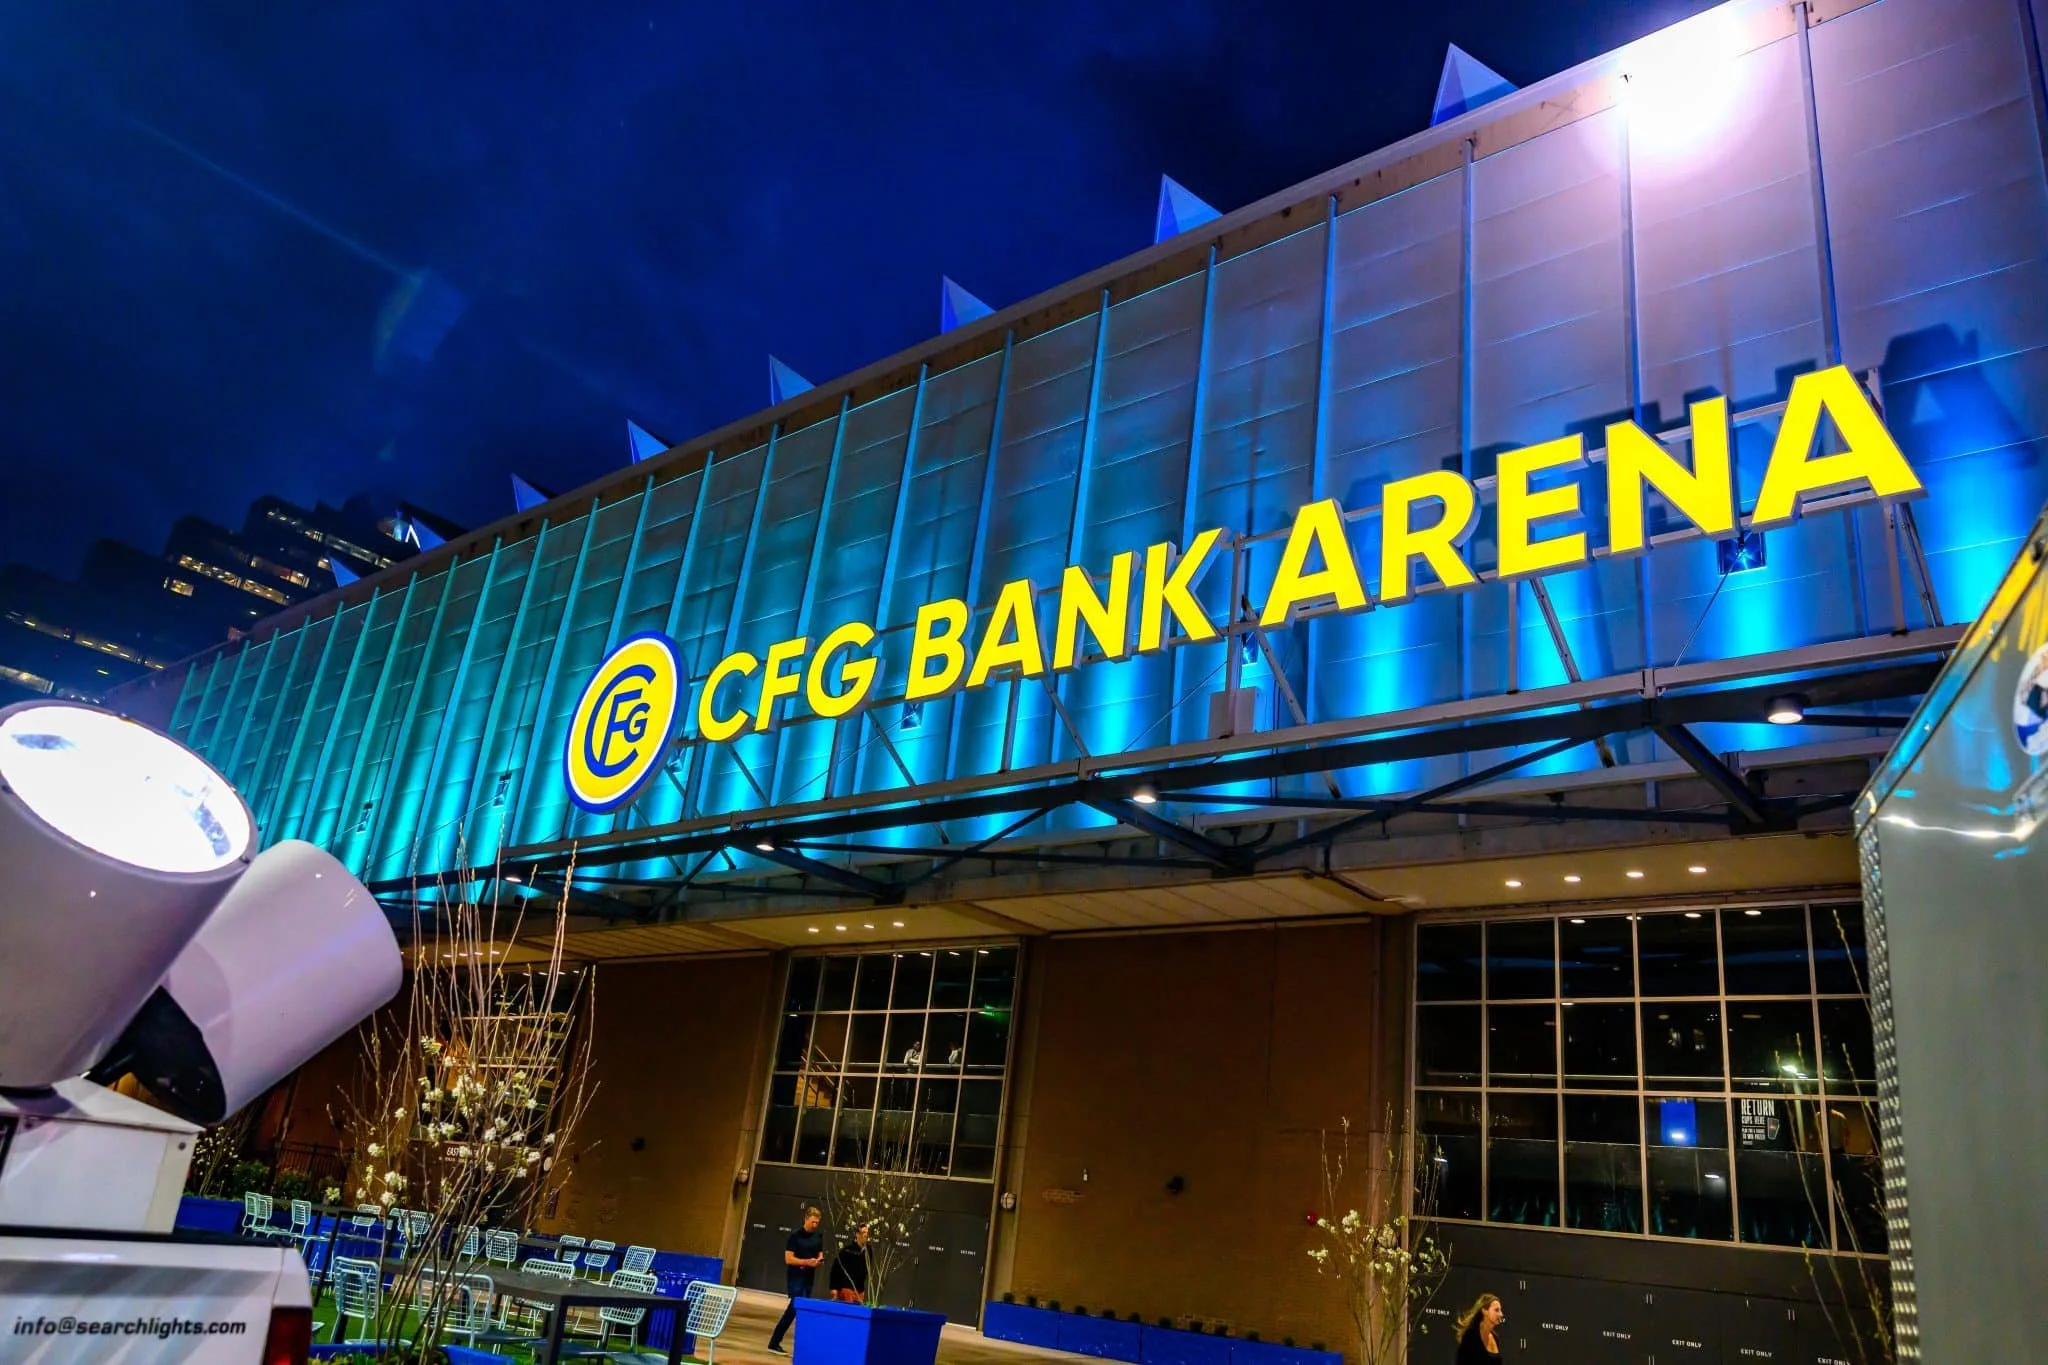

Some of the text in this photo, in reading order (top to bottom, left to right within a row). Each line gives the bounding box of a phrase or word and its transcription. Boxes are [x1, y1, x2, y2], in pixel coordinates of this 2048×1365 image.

[698, 365, 1922, 741] CFG BANK ARENA
[1741, 1099, 1775, 1116] RETURN
[13, 1316, 247, 1339] info@searchlights.com
[1616, 1332, 1631, 1340] ONLY
[1740, 1348, 1772, 1358] EXIT ONLY
[1817, 1357, 1832, 1365] EXIT
